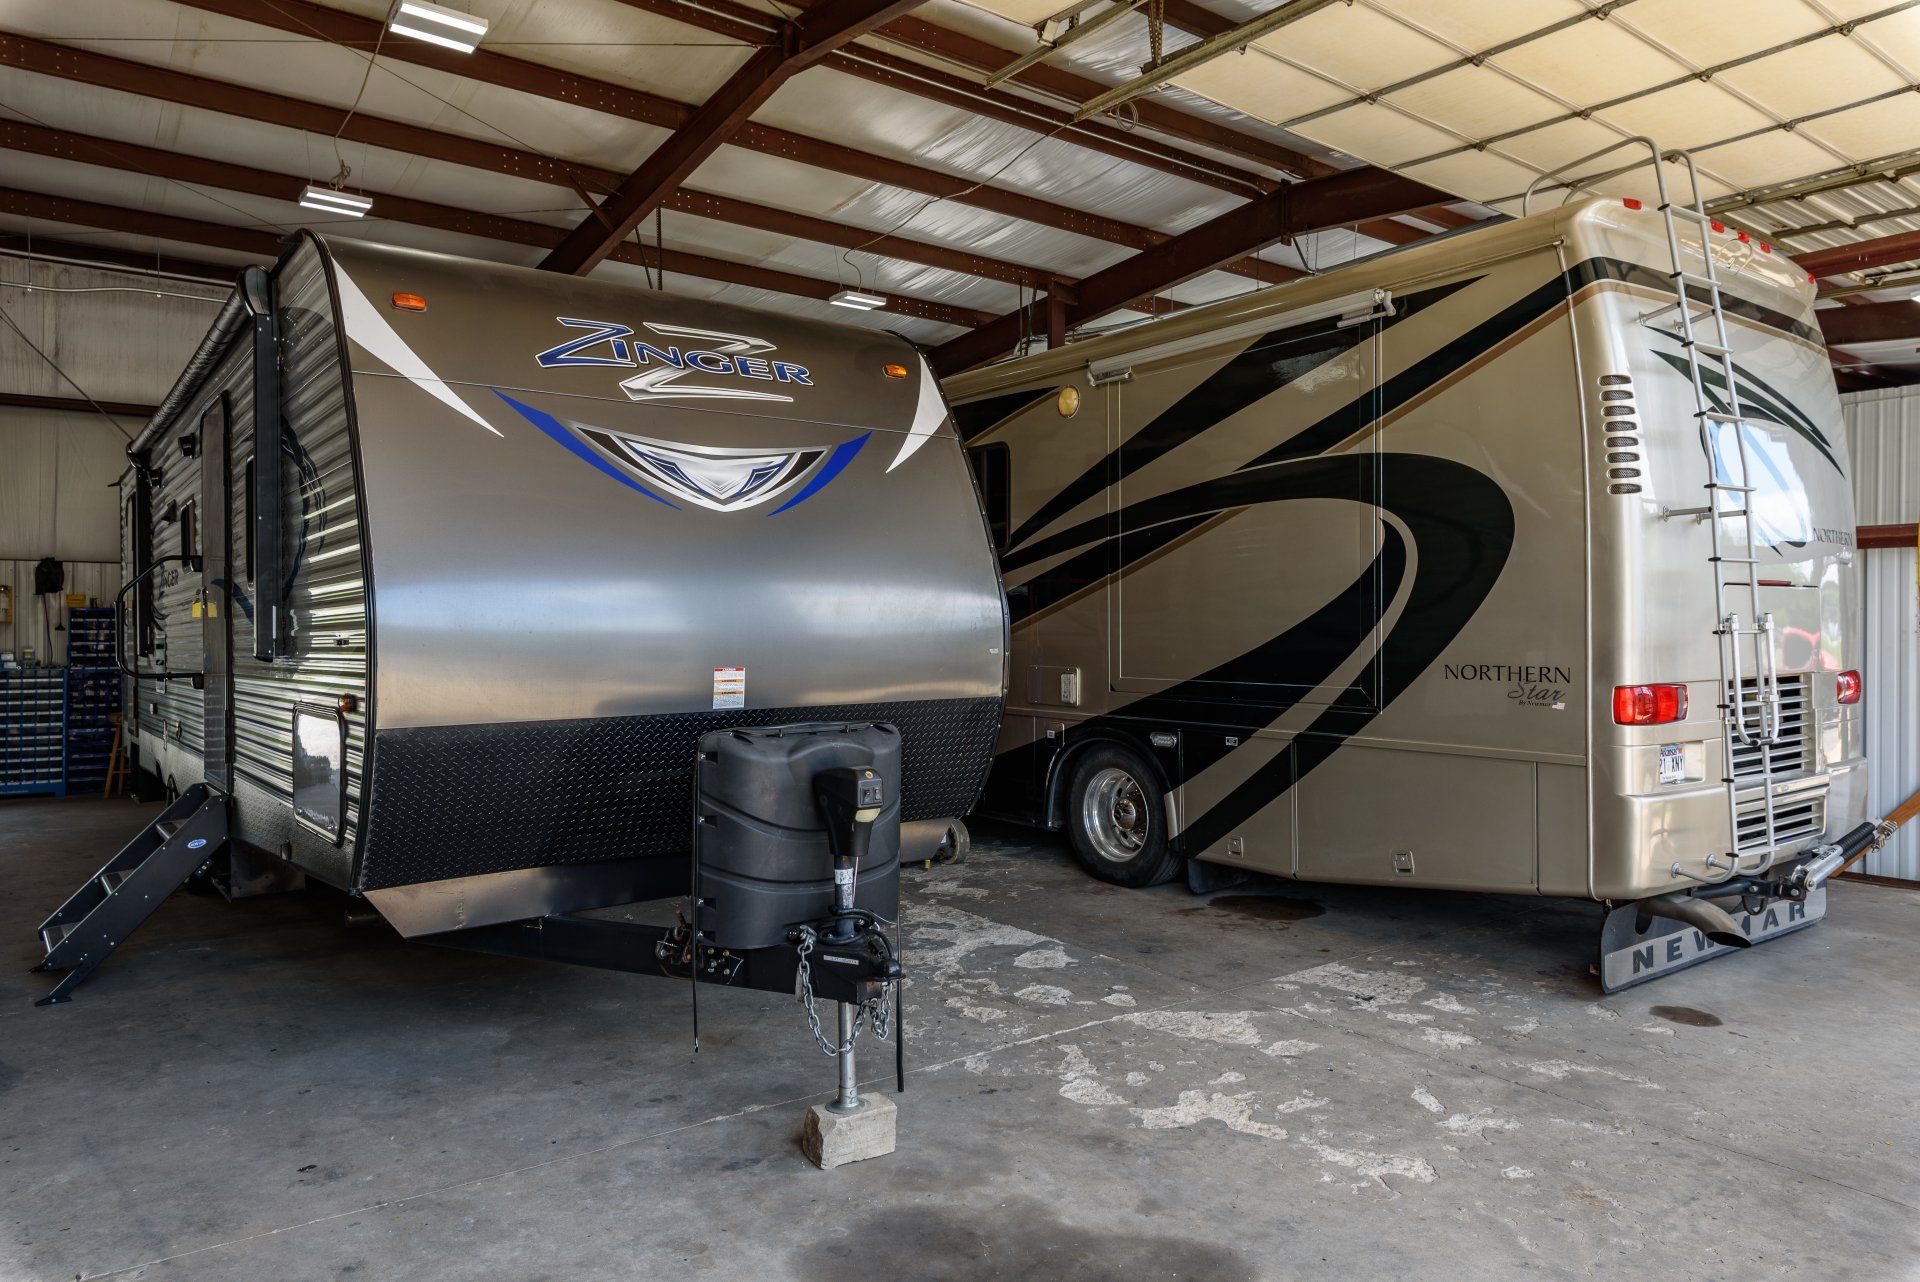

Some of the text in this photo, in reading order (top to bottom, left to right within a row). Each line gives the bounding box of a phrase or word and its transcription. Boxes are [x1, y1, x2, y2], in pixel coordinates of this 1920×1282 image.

[535, 316, 814, 386] ZINGER
[1444, 664, 1571, 683] NORTHERN
[1507, 681, 1566, 701] Star
